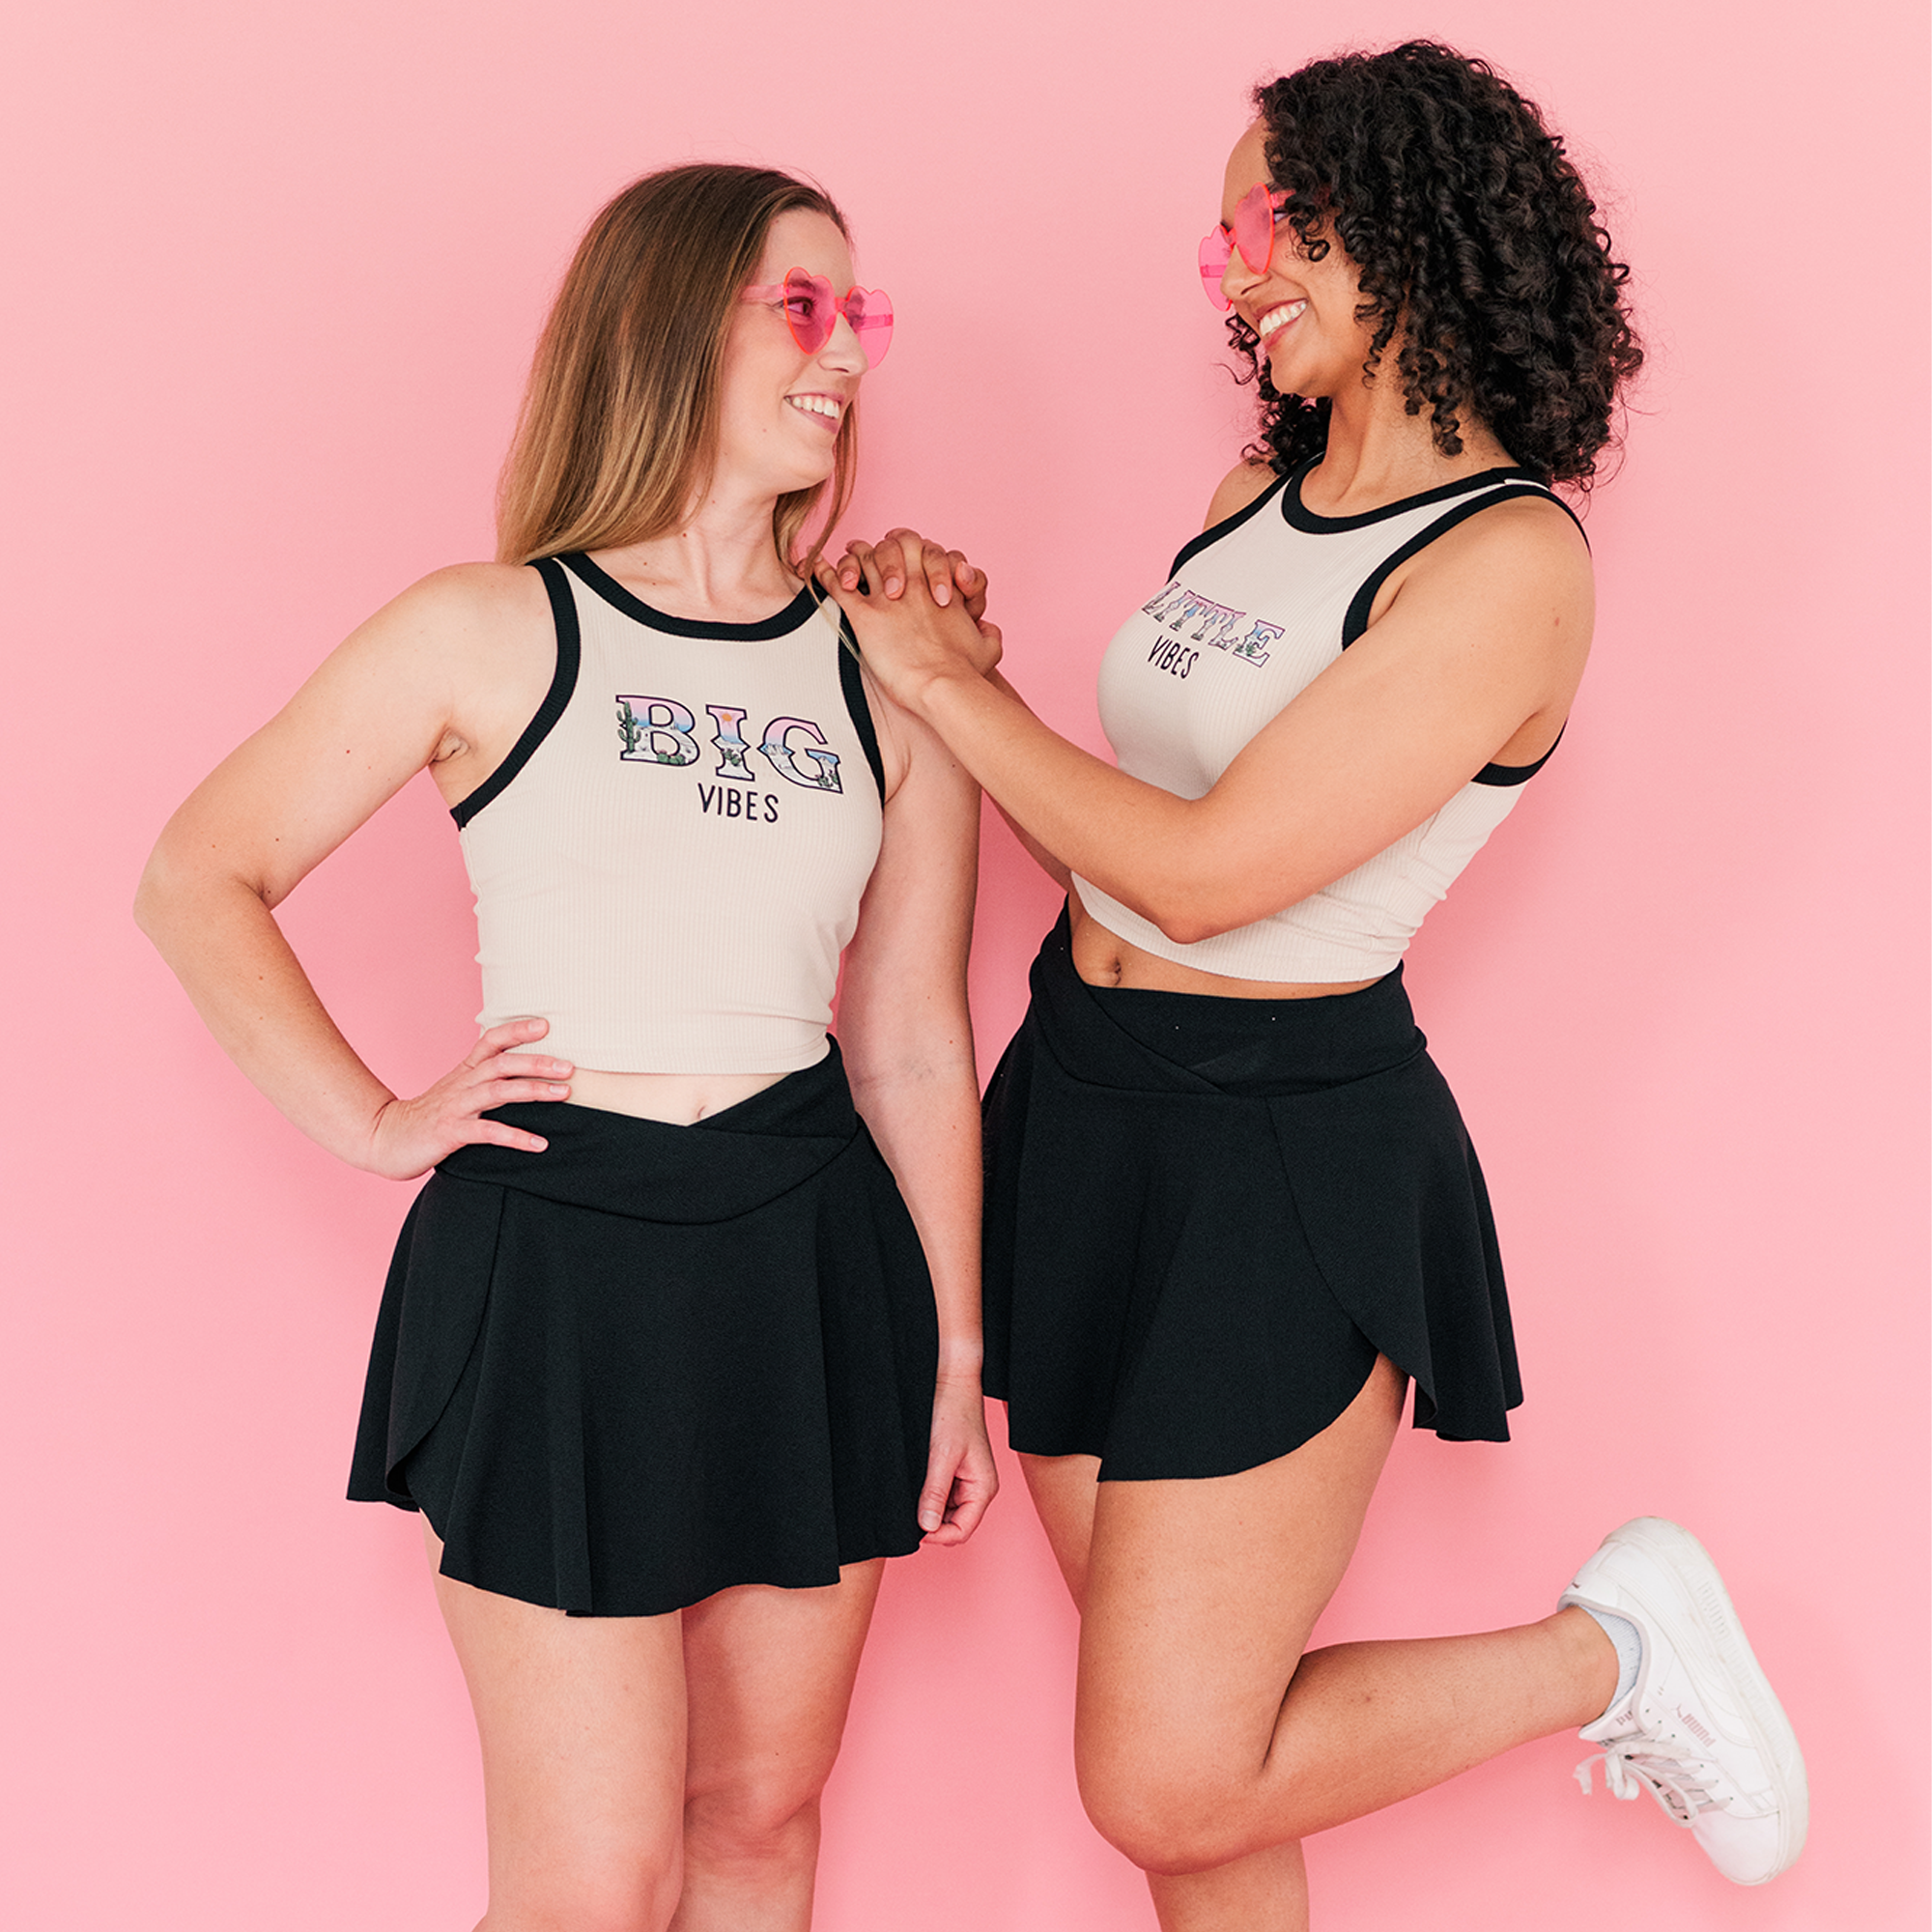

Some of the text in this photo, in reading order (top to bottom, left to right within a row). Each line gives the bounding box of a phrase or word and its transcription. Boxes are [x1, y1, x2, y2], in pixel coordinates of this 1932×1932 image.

[1142, 582, 1286, 668] LITTLE
[1148, 635, 1200, 679] VIBES
[615, 695, 843, 794] BIG
[698, 783, 780, 823] VIBES
